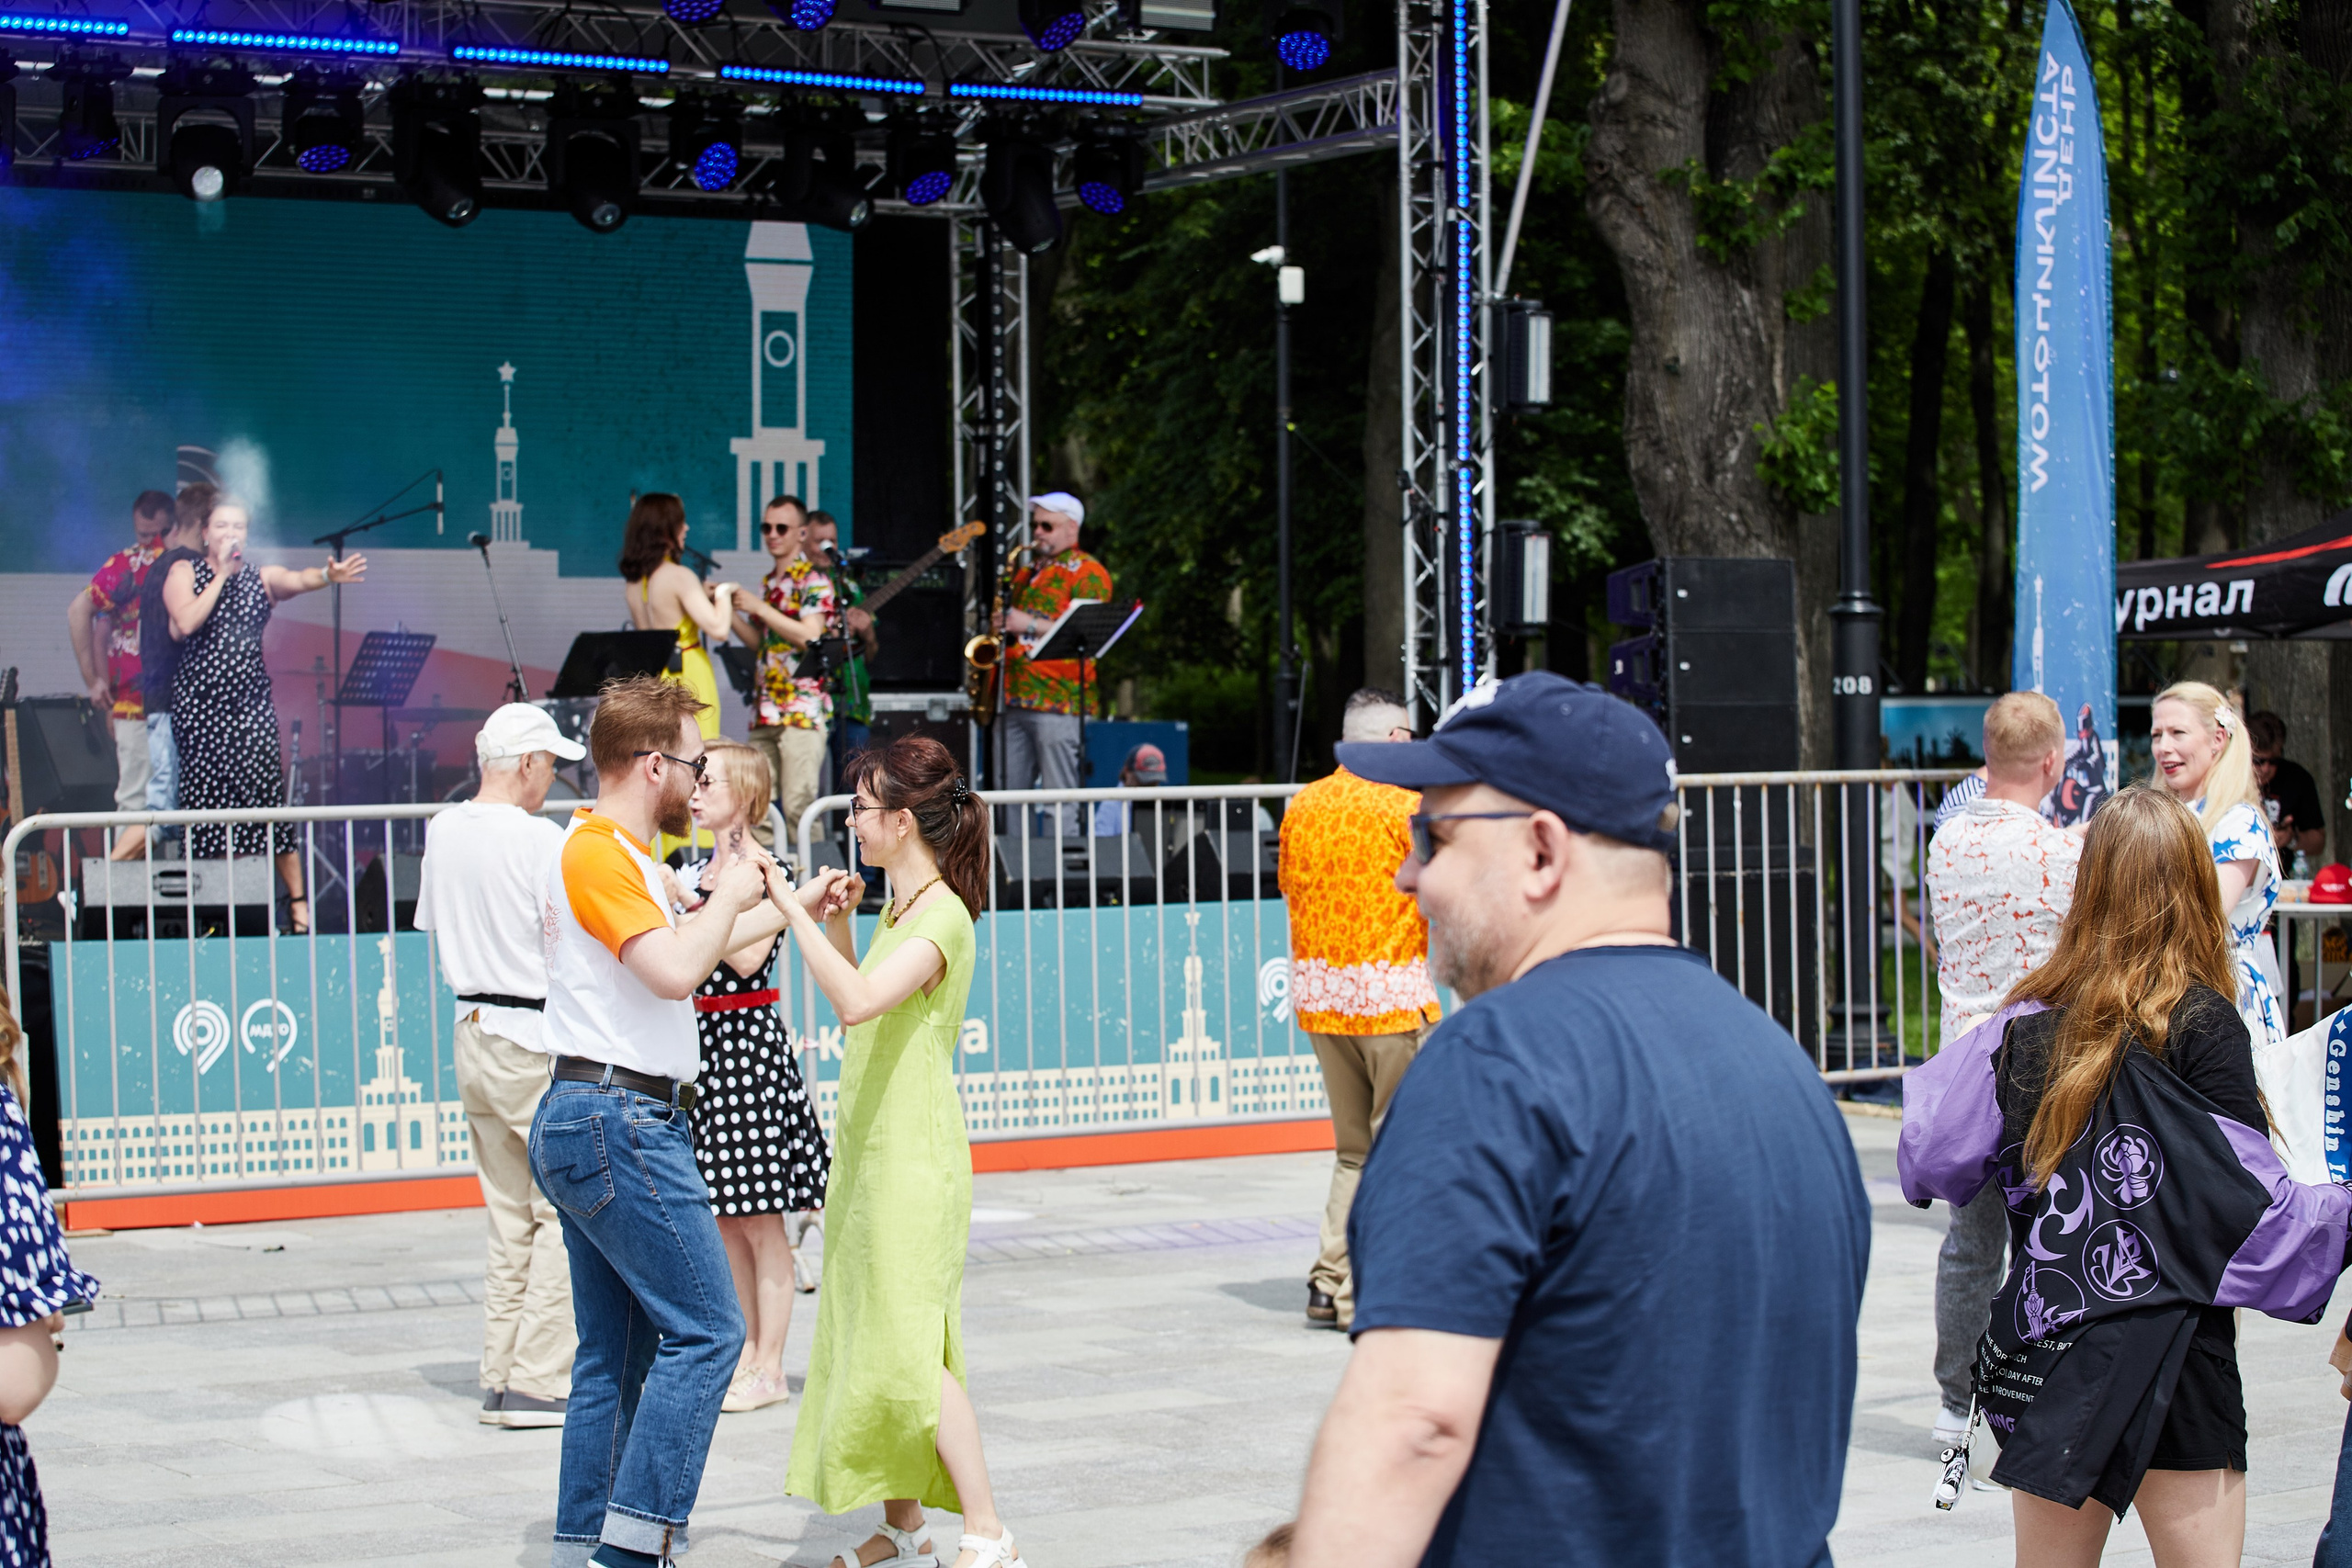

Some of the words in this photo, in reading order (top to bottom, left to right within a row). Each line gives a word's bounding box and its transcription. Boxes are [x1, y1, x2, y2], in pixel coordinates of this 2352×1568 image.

[2115, 579, 2255, 633] урнал
[1832, 675, 1872, 695] 208
[2324, 1039, 2346, 1152] Genshin
[2021, 1373, 2044, 1386] AFTER
